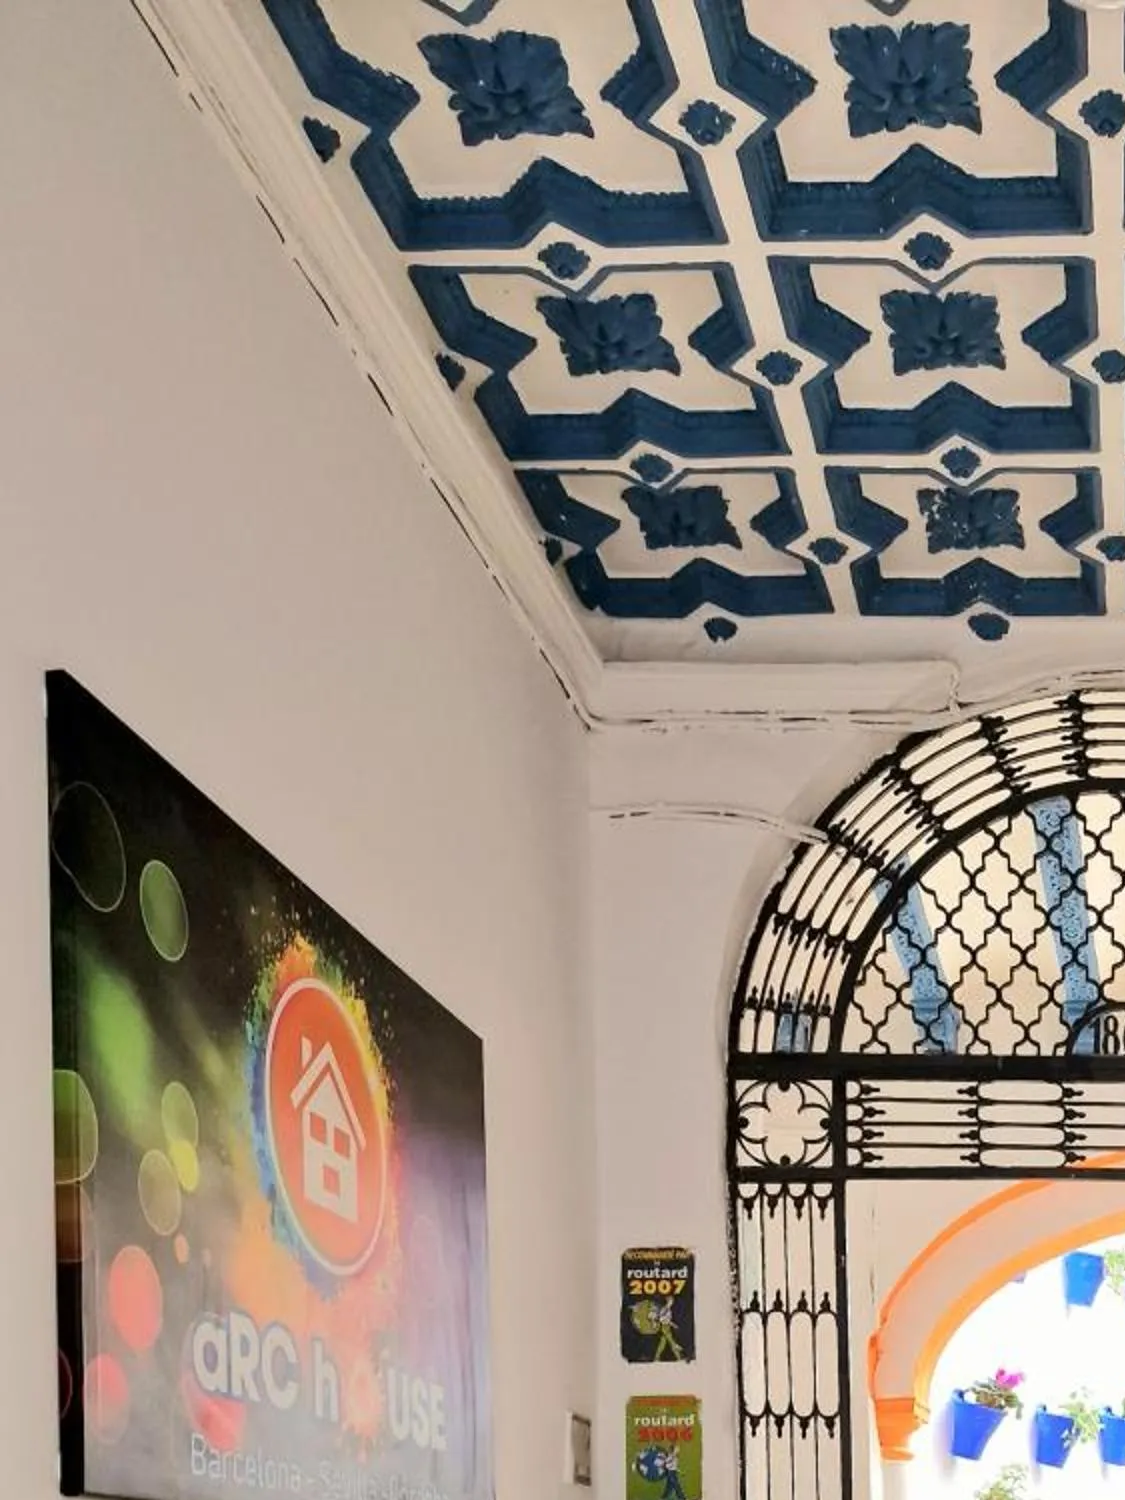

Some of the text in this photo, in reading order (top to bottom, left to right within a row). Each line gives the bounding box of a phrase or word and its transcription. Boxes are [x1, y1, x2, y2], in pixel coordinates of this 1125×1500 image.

[626, 1265, 689, 1279] routard
[628, 1279, 687, 1296] 2007
[634, 1413, 695, 1427] routard
[191, 1432, 302, 1494] Barcelona
